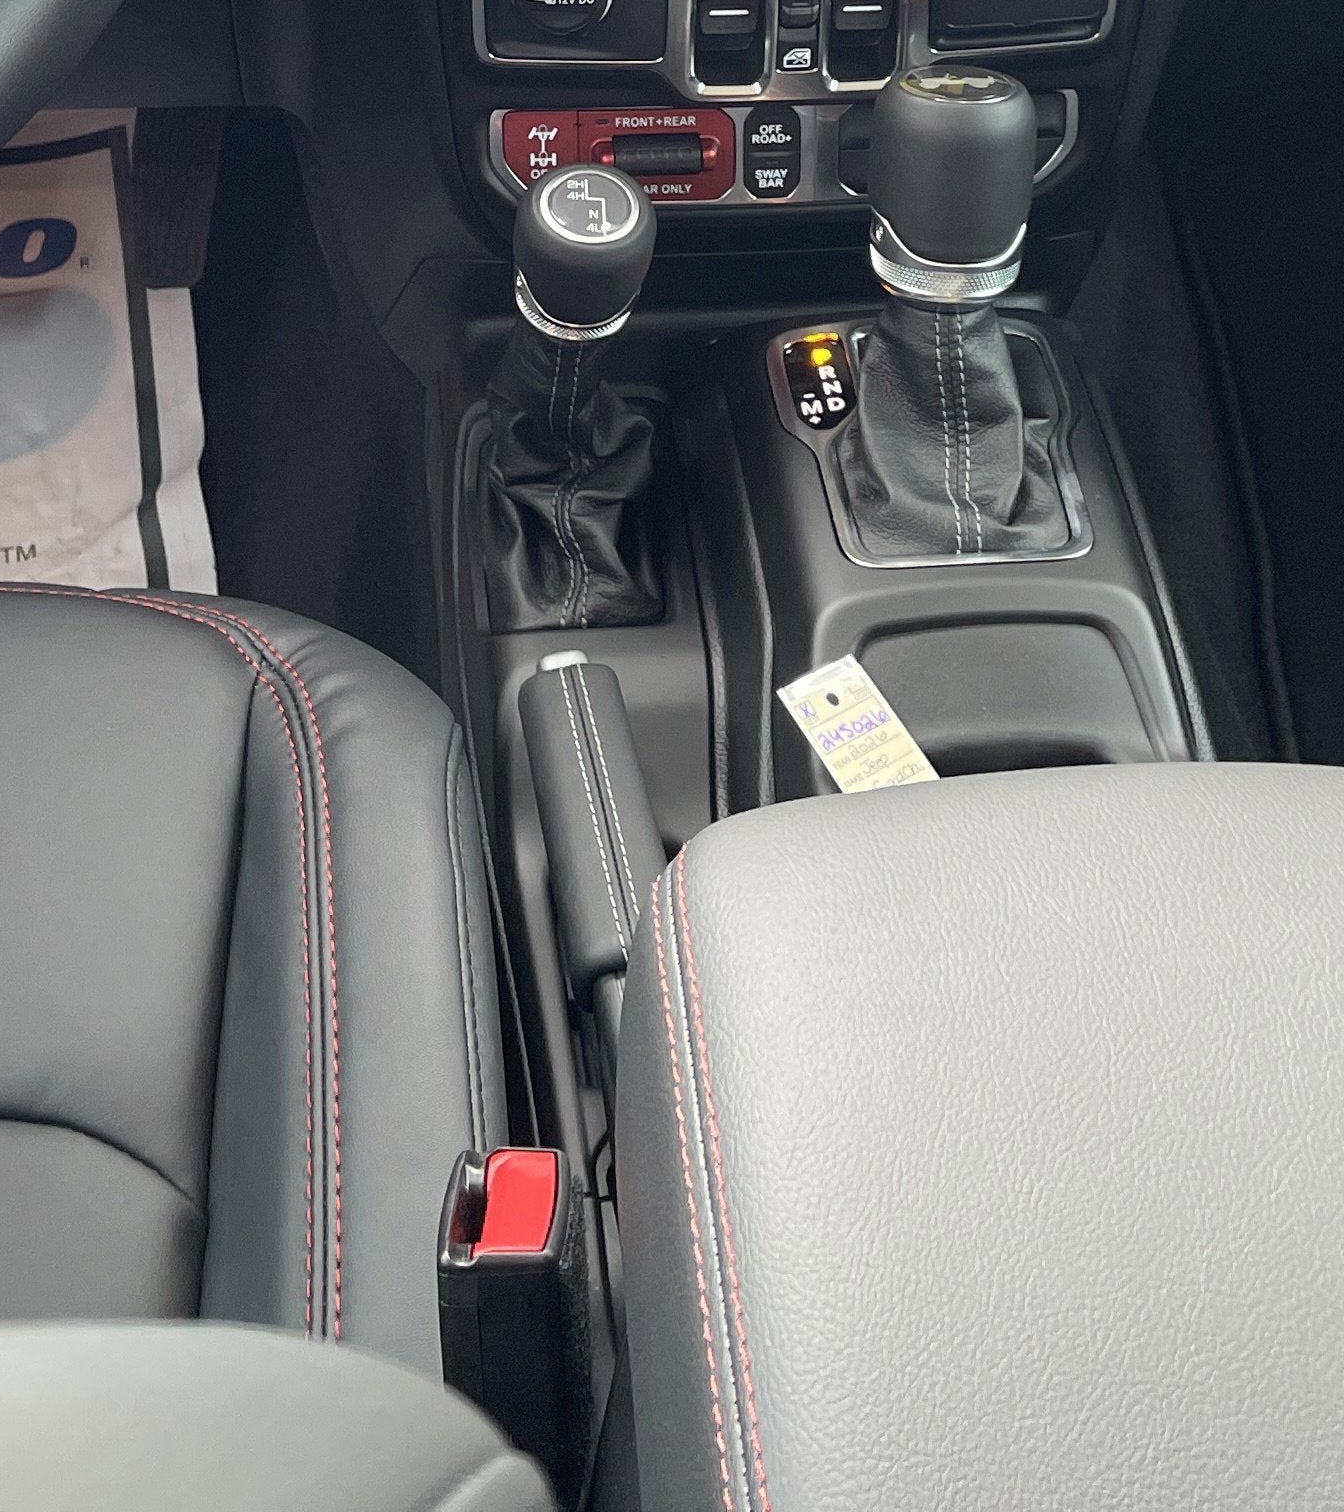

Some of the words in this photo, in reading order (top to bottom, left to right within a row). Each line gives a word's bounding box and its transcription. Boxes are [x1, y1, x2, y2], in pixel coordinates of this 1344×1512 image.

[759, 124, 783, 136] OFF
[751, 134, 792, 144] ROAD+
[755, 169, 788, 181] SWAY
[567, 180, 583, 189] 2H
[642, 185, 658, 194] AR
[661, 184, 692, 194] ONLY
[759, 179, 784, 188] BAR
[567, 192, 584, 200] 4H
[589, 209, 599, 219] N
[818, 365, 837, 380] R
[822, 380, 842, 396] N
[800, 399, 824, 416] M
[827, 397, 846, 412] D
